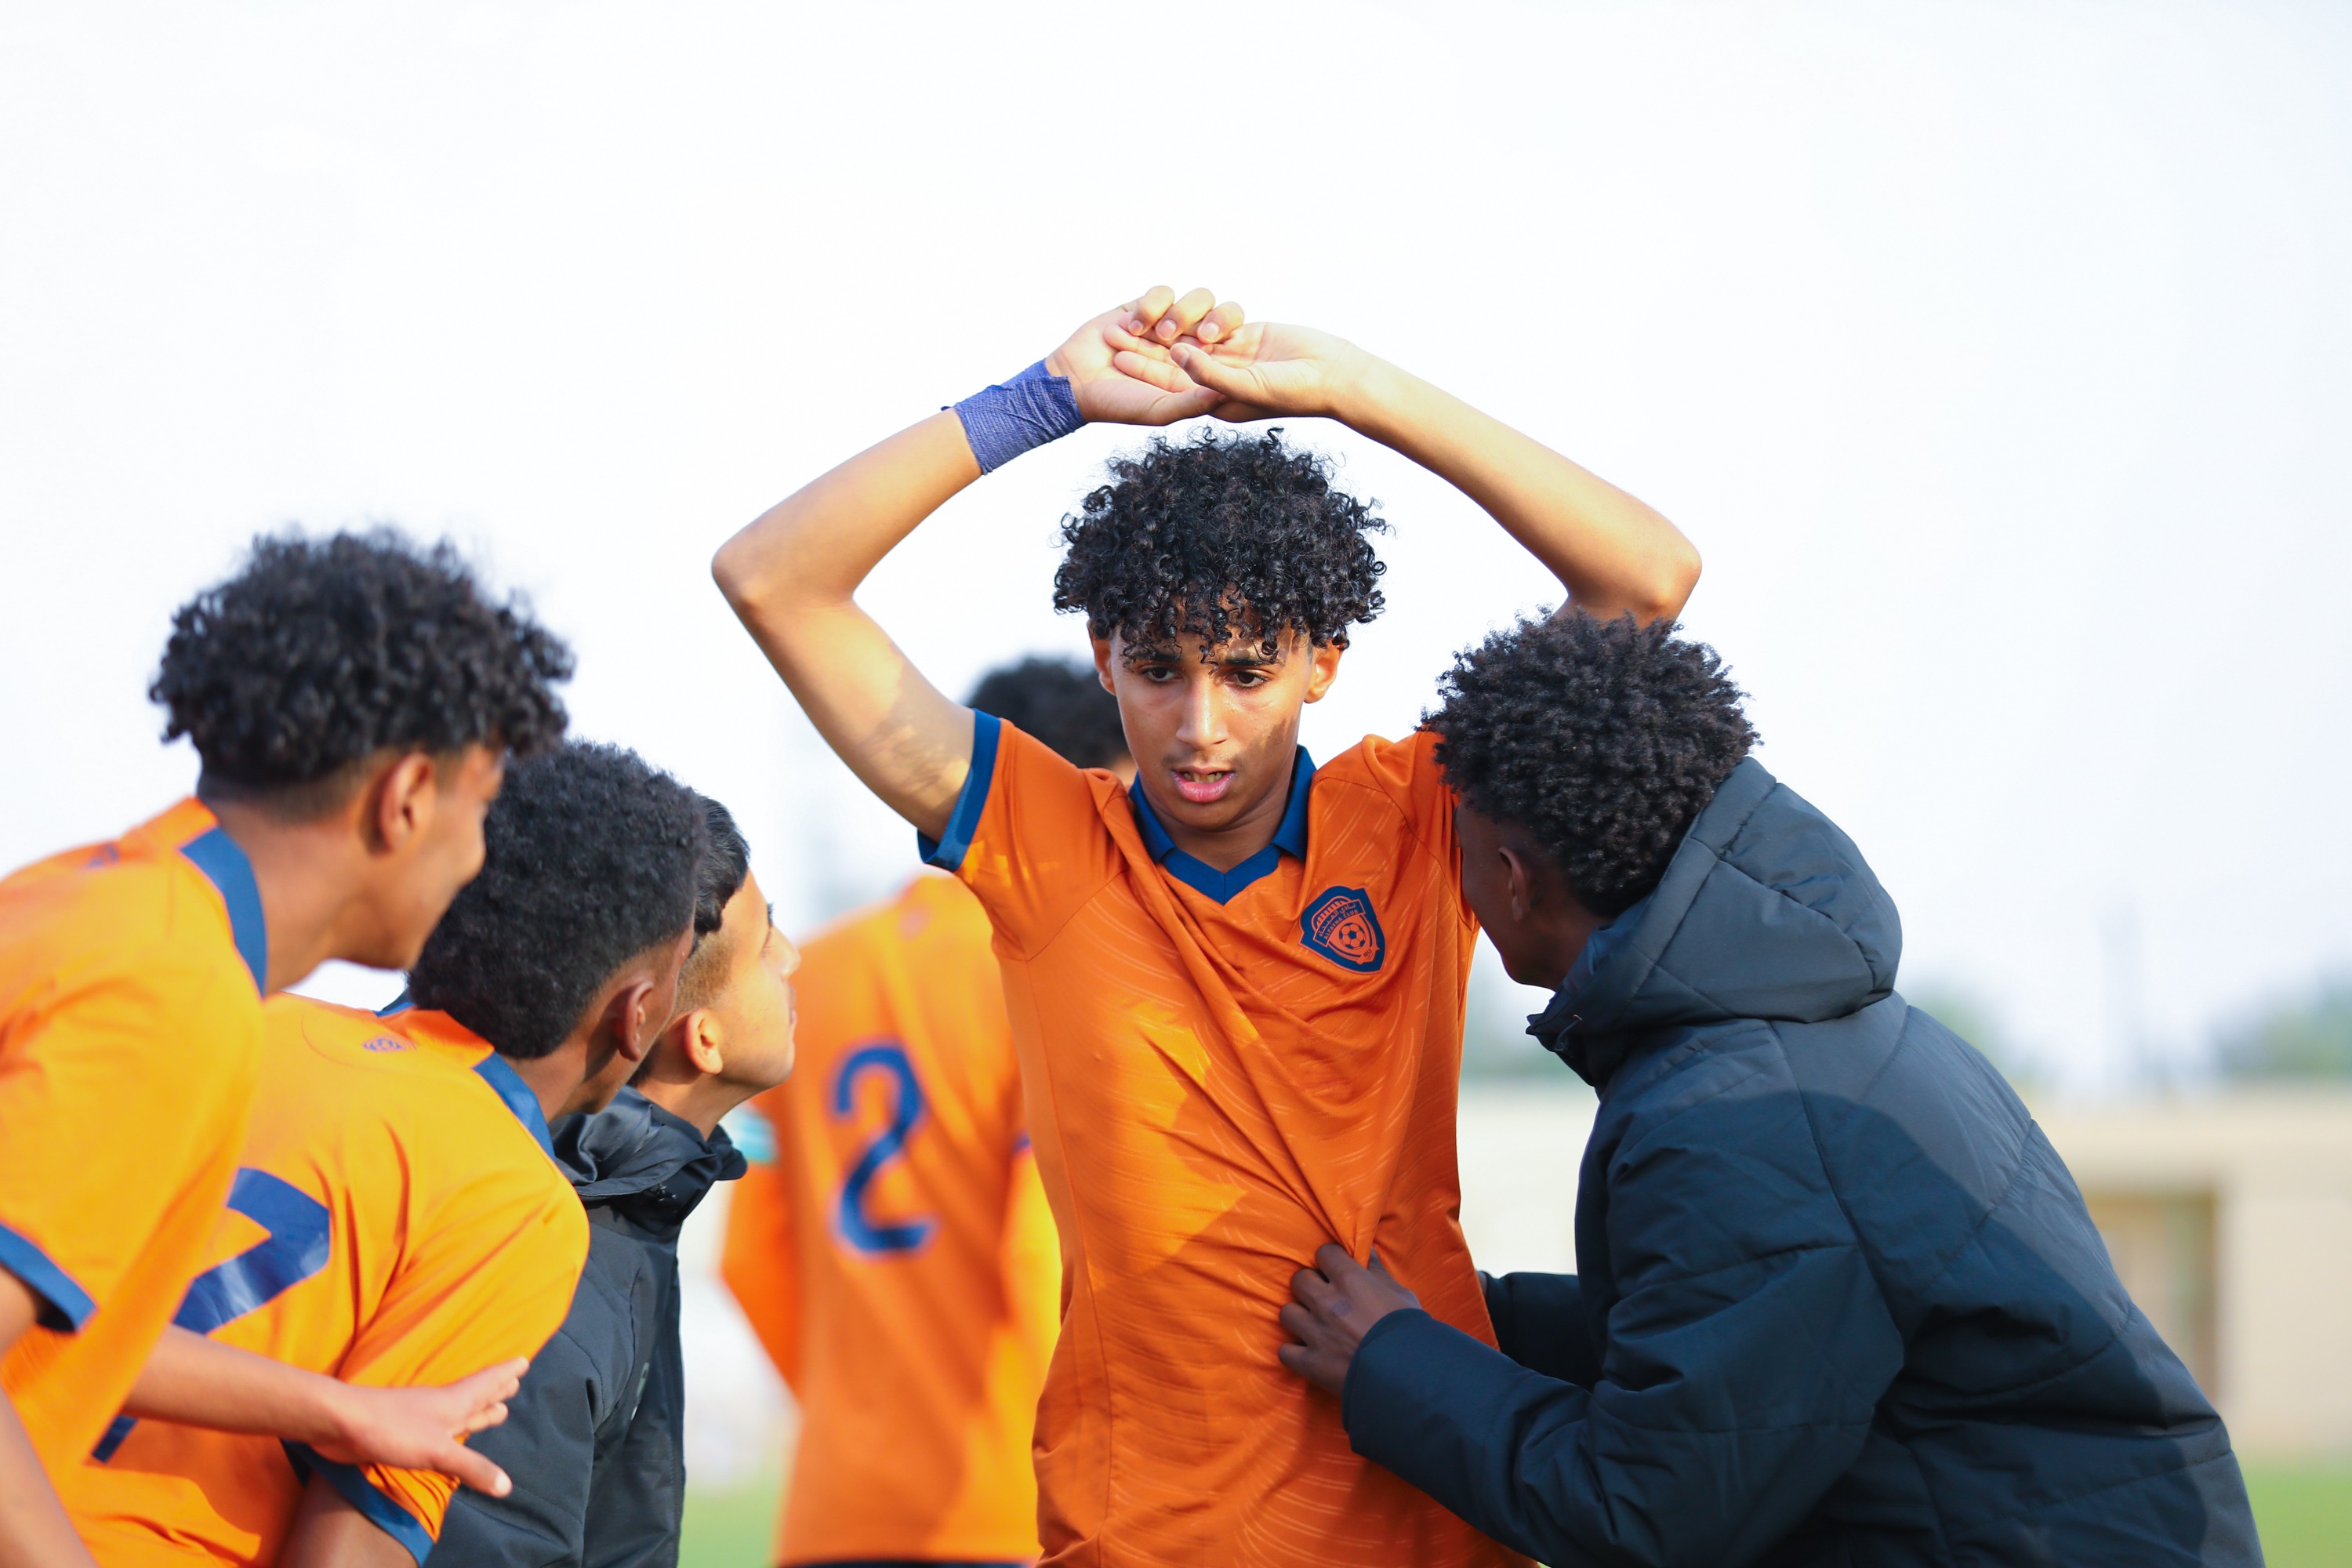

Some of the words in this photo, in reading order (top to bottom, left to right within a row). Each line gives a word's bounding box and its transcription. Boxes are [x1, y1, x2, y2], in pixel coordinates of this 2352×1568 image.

[1323, 916, 1343, 940] ALFAYHA
[1343, 909, 1359, 918] CLUB
[833, 1044, 933, 1253] 2
